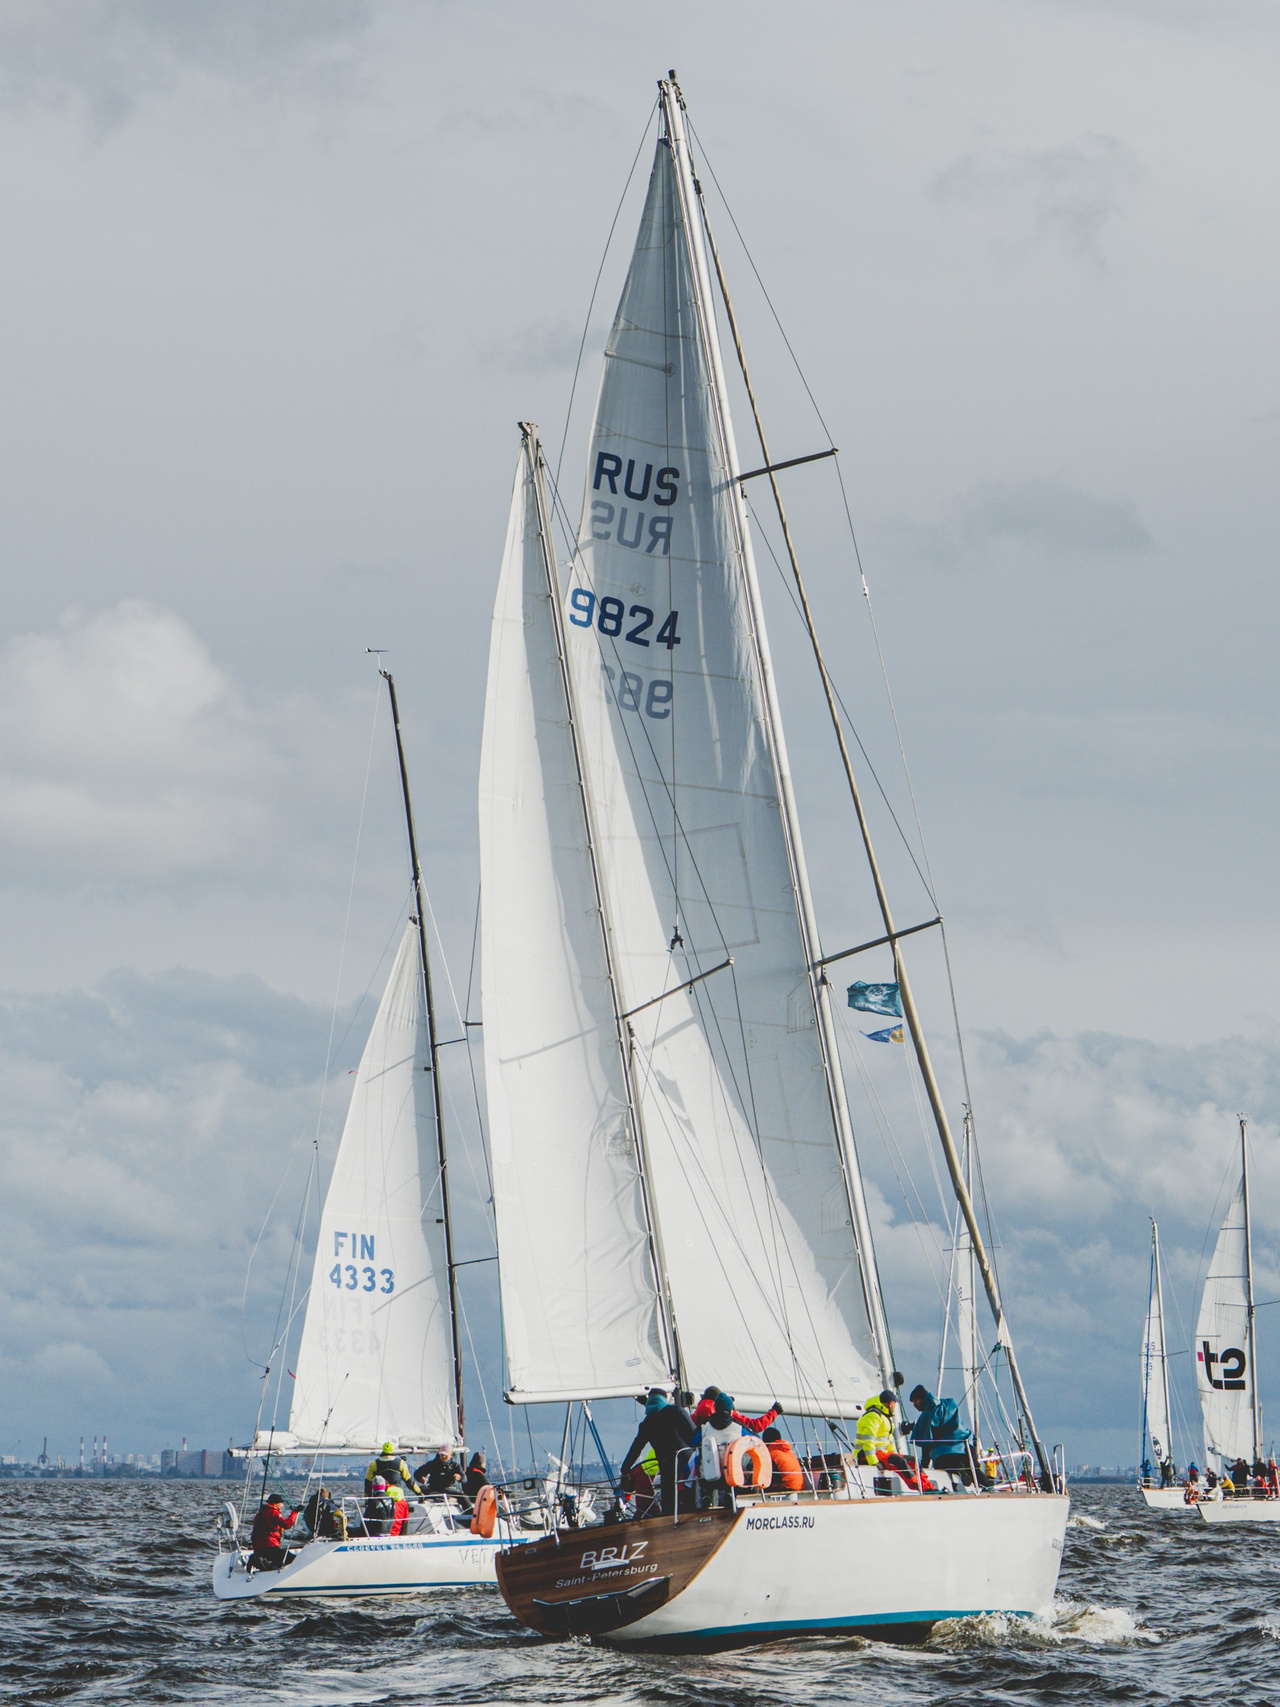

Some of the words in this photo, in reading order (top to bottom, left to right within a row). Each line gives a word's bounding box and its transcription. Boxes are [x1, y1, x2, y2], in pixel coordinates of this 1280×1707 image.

[593, 451, 680, 506] RUS
[569, 588, 681, 650] 9824
[334, 1231, 375, 1261] FIN
[329, 1263, 394, 1294] 4333
[746, 1515, 815, 1530] MORCLASS.RU
[580, 1541, 649, 1569] BRIZ
[555, 1563, 658, 1588] Saint-Petersburg
